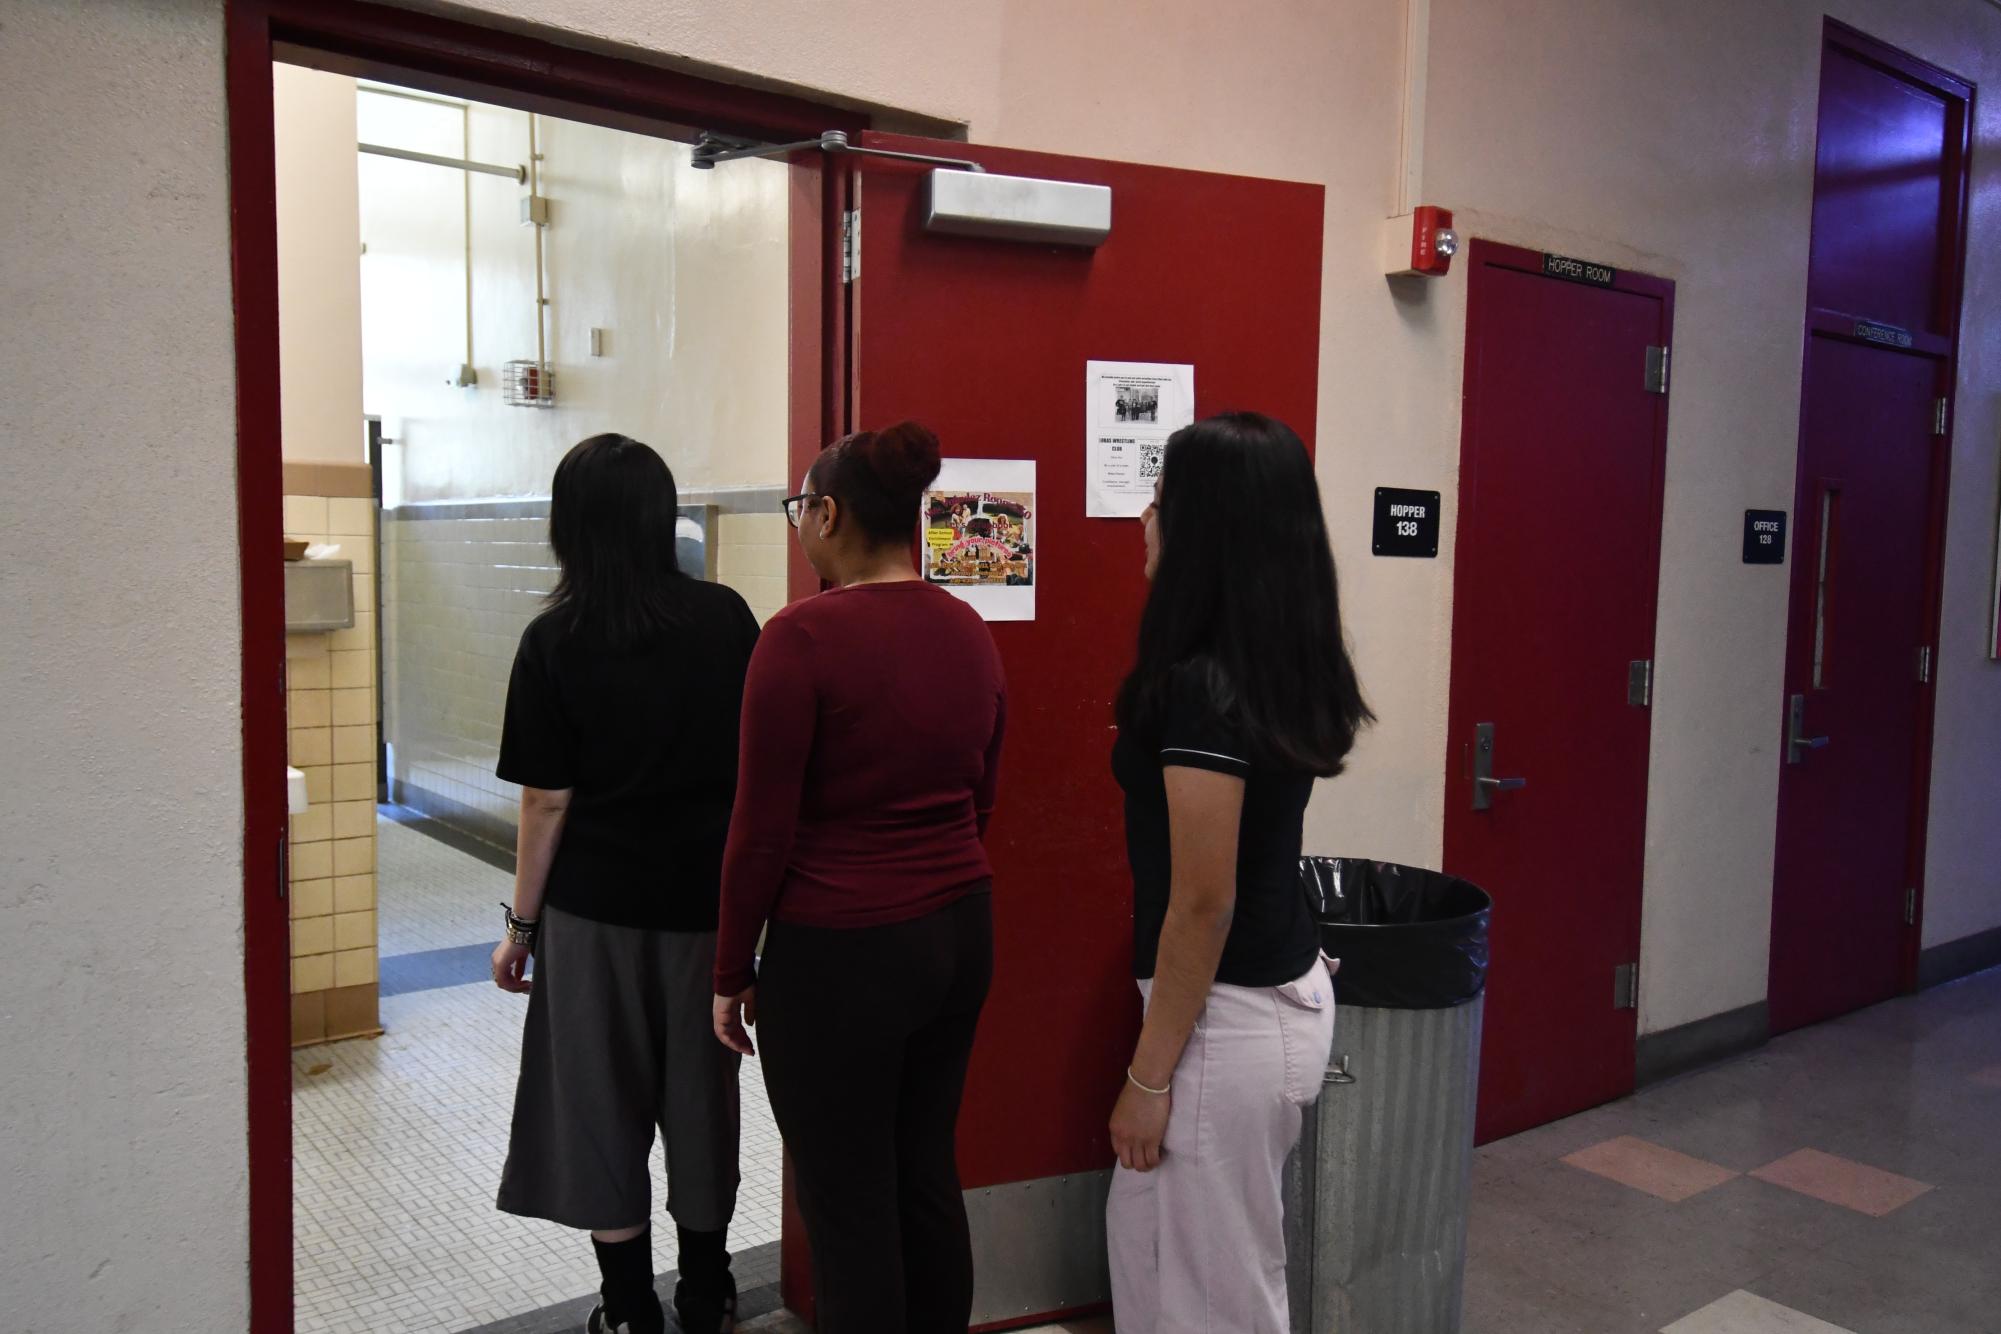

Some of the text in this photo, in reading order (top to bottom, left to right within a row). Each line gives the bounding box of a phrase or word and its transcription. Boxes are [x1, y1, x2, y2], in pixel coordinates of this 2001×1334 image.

[1419, 227, 1428, 256] FIRE
[1548, 256, 1611, 283] HOPPER ROOM
[1857, 324, 1895, 342] CONFERENCE
[1390, 504, 1426, 518] HOPPER
[1396, 521, 1418, 536] 138
[1753, 520, 1779, 532] OFFICE
[1759, 534, 1772, 544] 128
